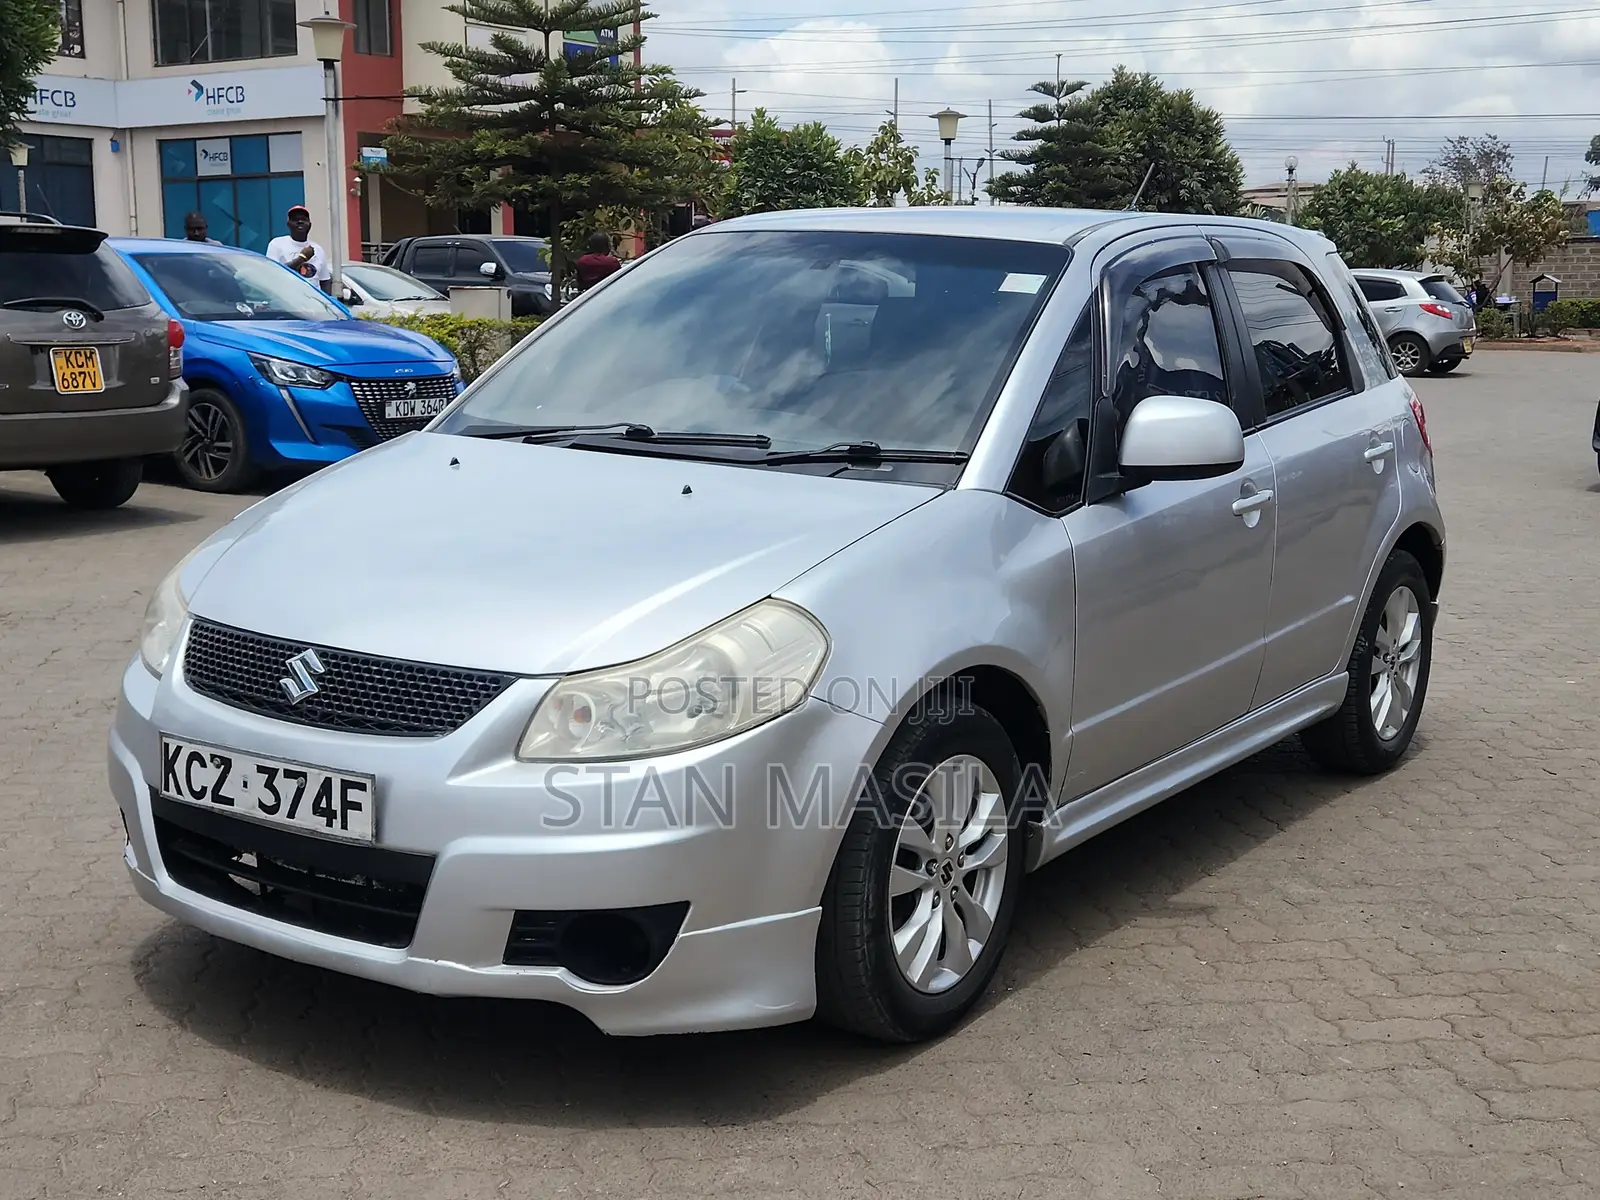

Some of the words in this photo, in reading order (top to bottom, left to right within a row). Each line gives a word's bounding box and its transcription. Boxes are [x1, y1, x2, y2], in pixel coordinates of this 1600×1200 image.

[600, 28, 614, 39] ATM
[205, 86, 246, 106] HFCB
[208, 152, 229, 162] HFCB
[63, 350, 96, 369] KCM
[61, 370, 97, 390] 687V
[395, 400, 417, 417] KDW
[163, 742, 235, 807] KCZ
[255, 764, 368, 831] 374F
